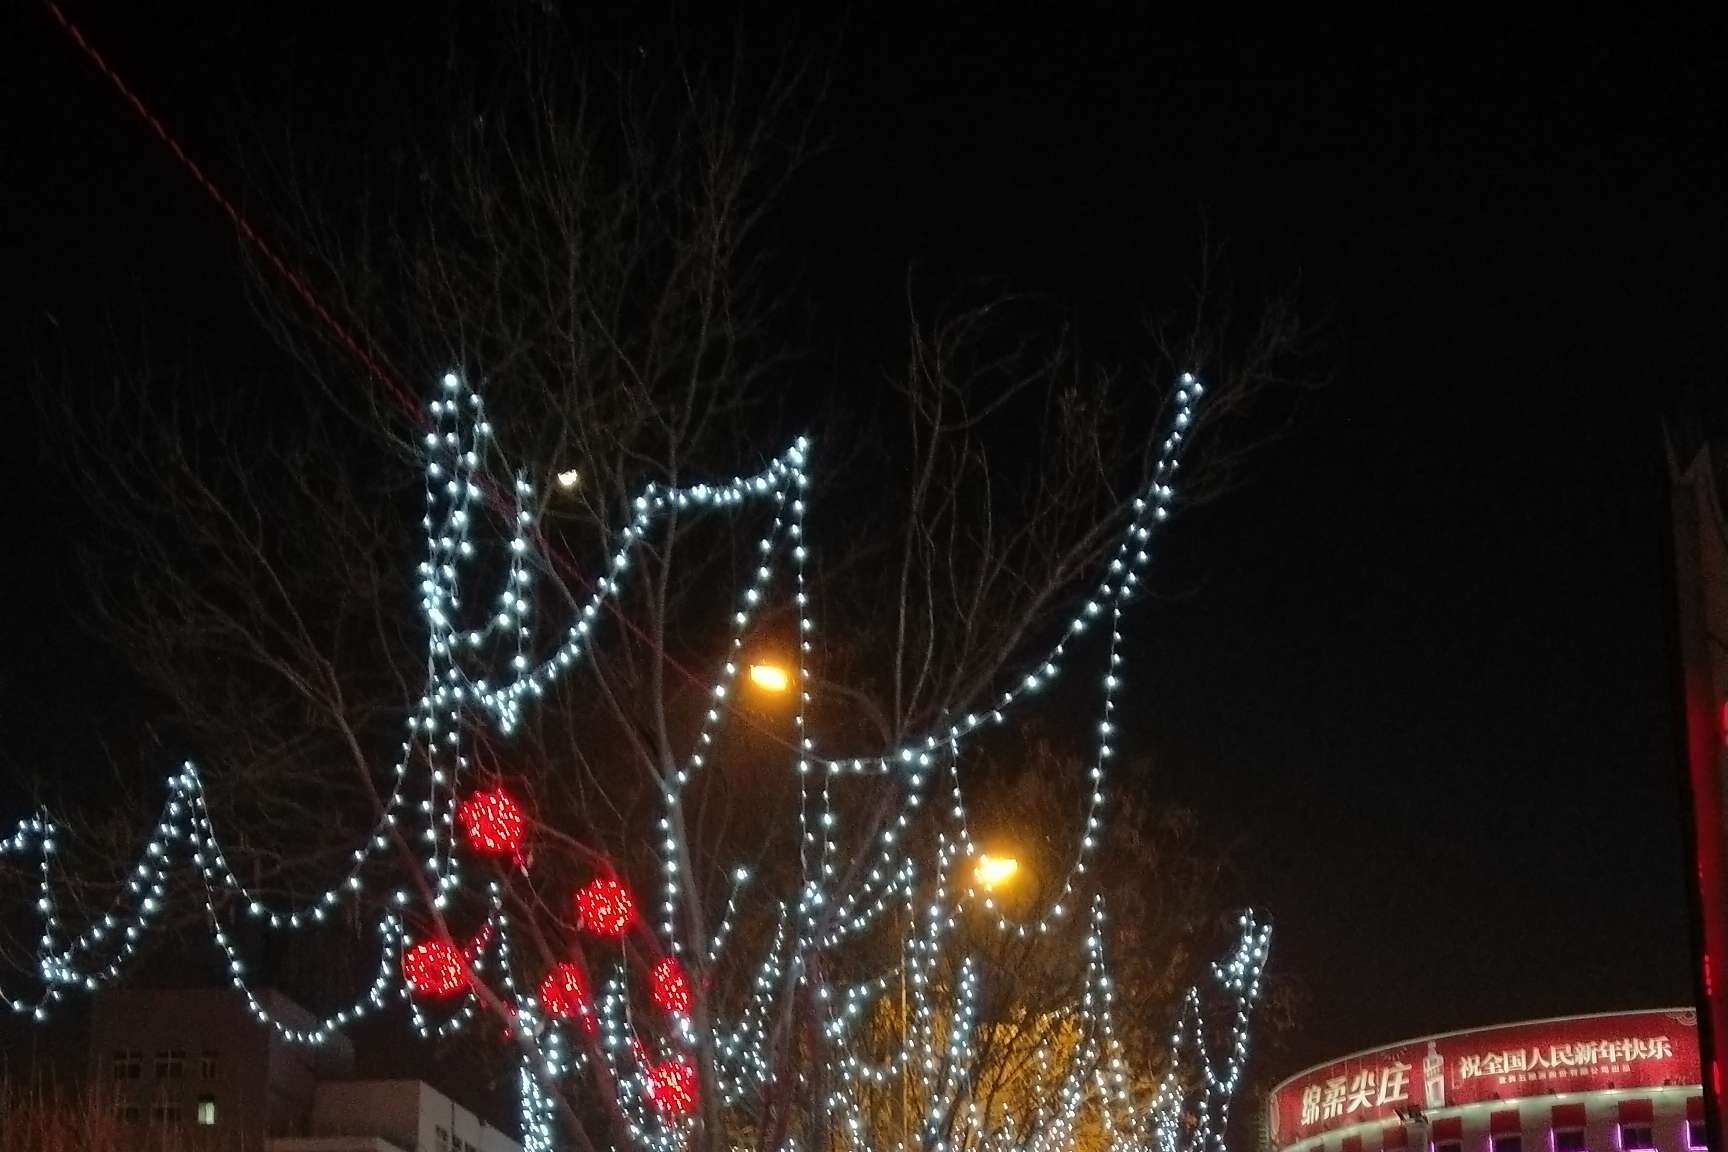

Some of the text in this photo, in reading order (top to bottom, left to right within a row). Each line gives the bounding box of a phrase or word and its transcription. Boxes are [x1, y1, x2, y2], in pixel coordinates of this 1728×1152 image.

[1460, 1036, 1673, 1080] 祝全国人民新年快乐
[1301, 1061, 1413, 1126] 绵柔尖庄
